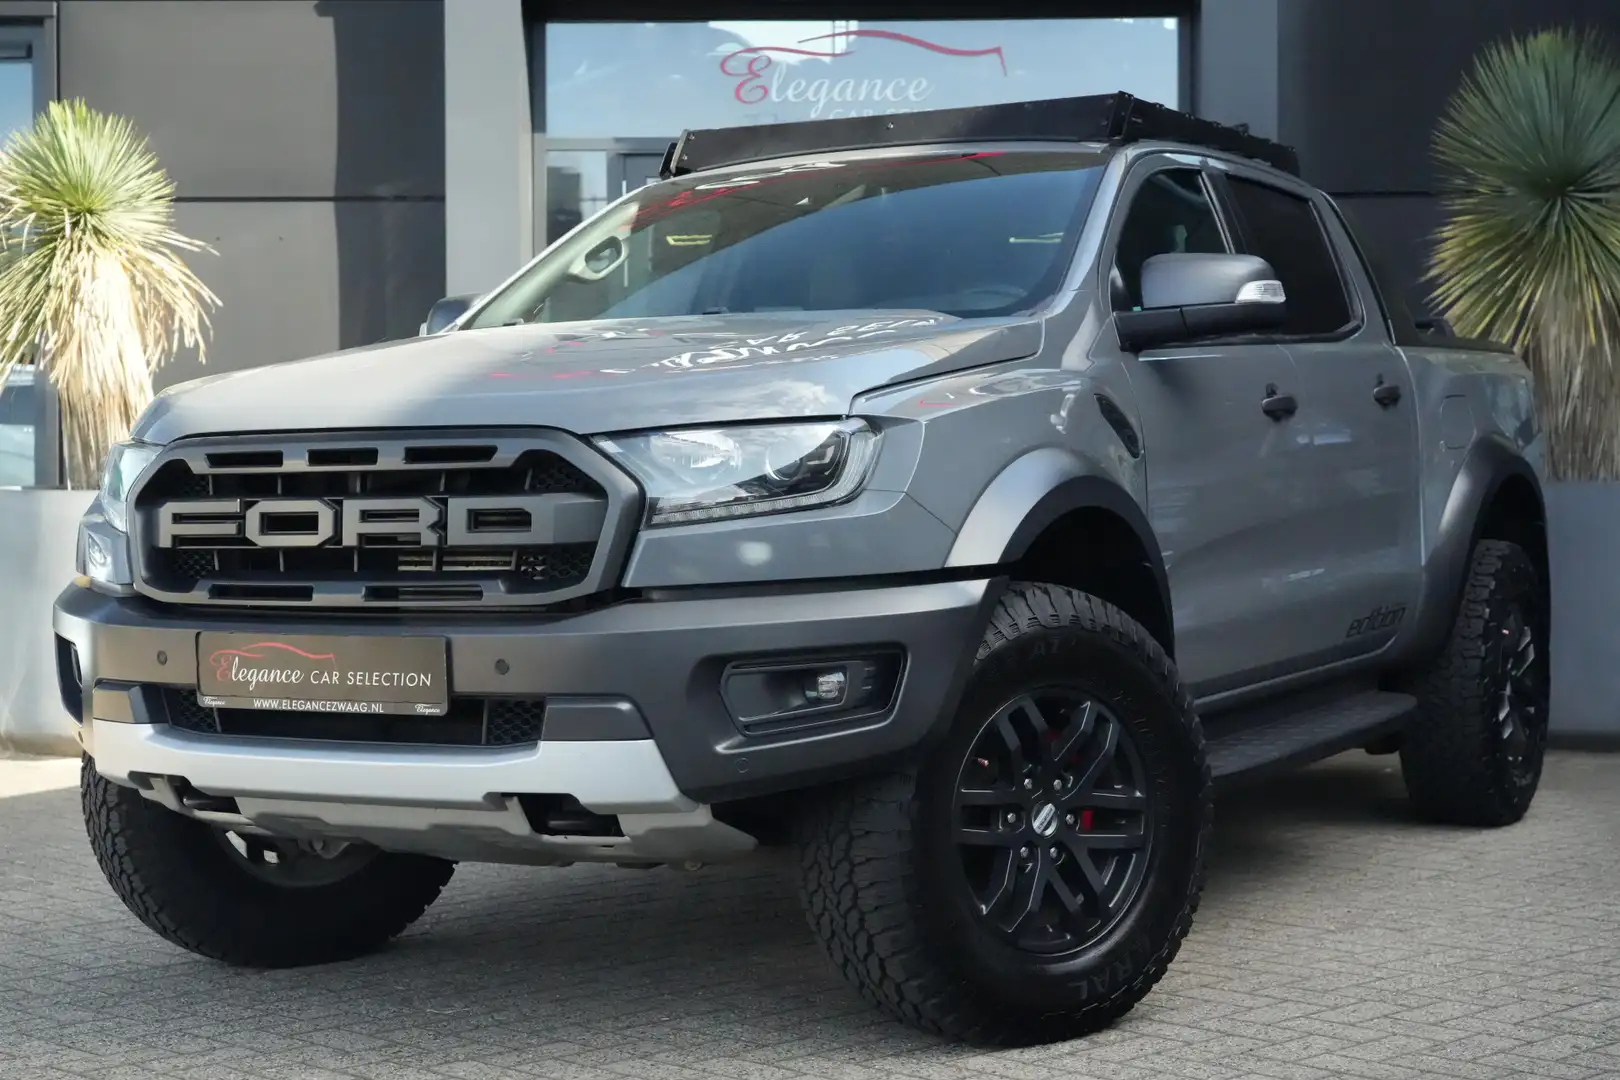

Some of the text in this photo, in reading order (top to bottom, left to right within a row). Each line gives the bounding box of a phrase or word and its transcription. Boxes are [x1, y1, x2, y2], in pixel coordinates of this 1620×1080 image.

[720, 53, 934, 118] Elegance
[158, 496, 555, 548] FORD
[210, 654, 432, 691] Elegance CAR SELECTION
[253, 698, 384, 713] WWW.ELEGANCEZWAAG.NL
